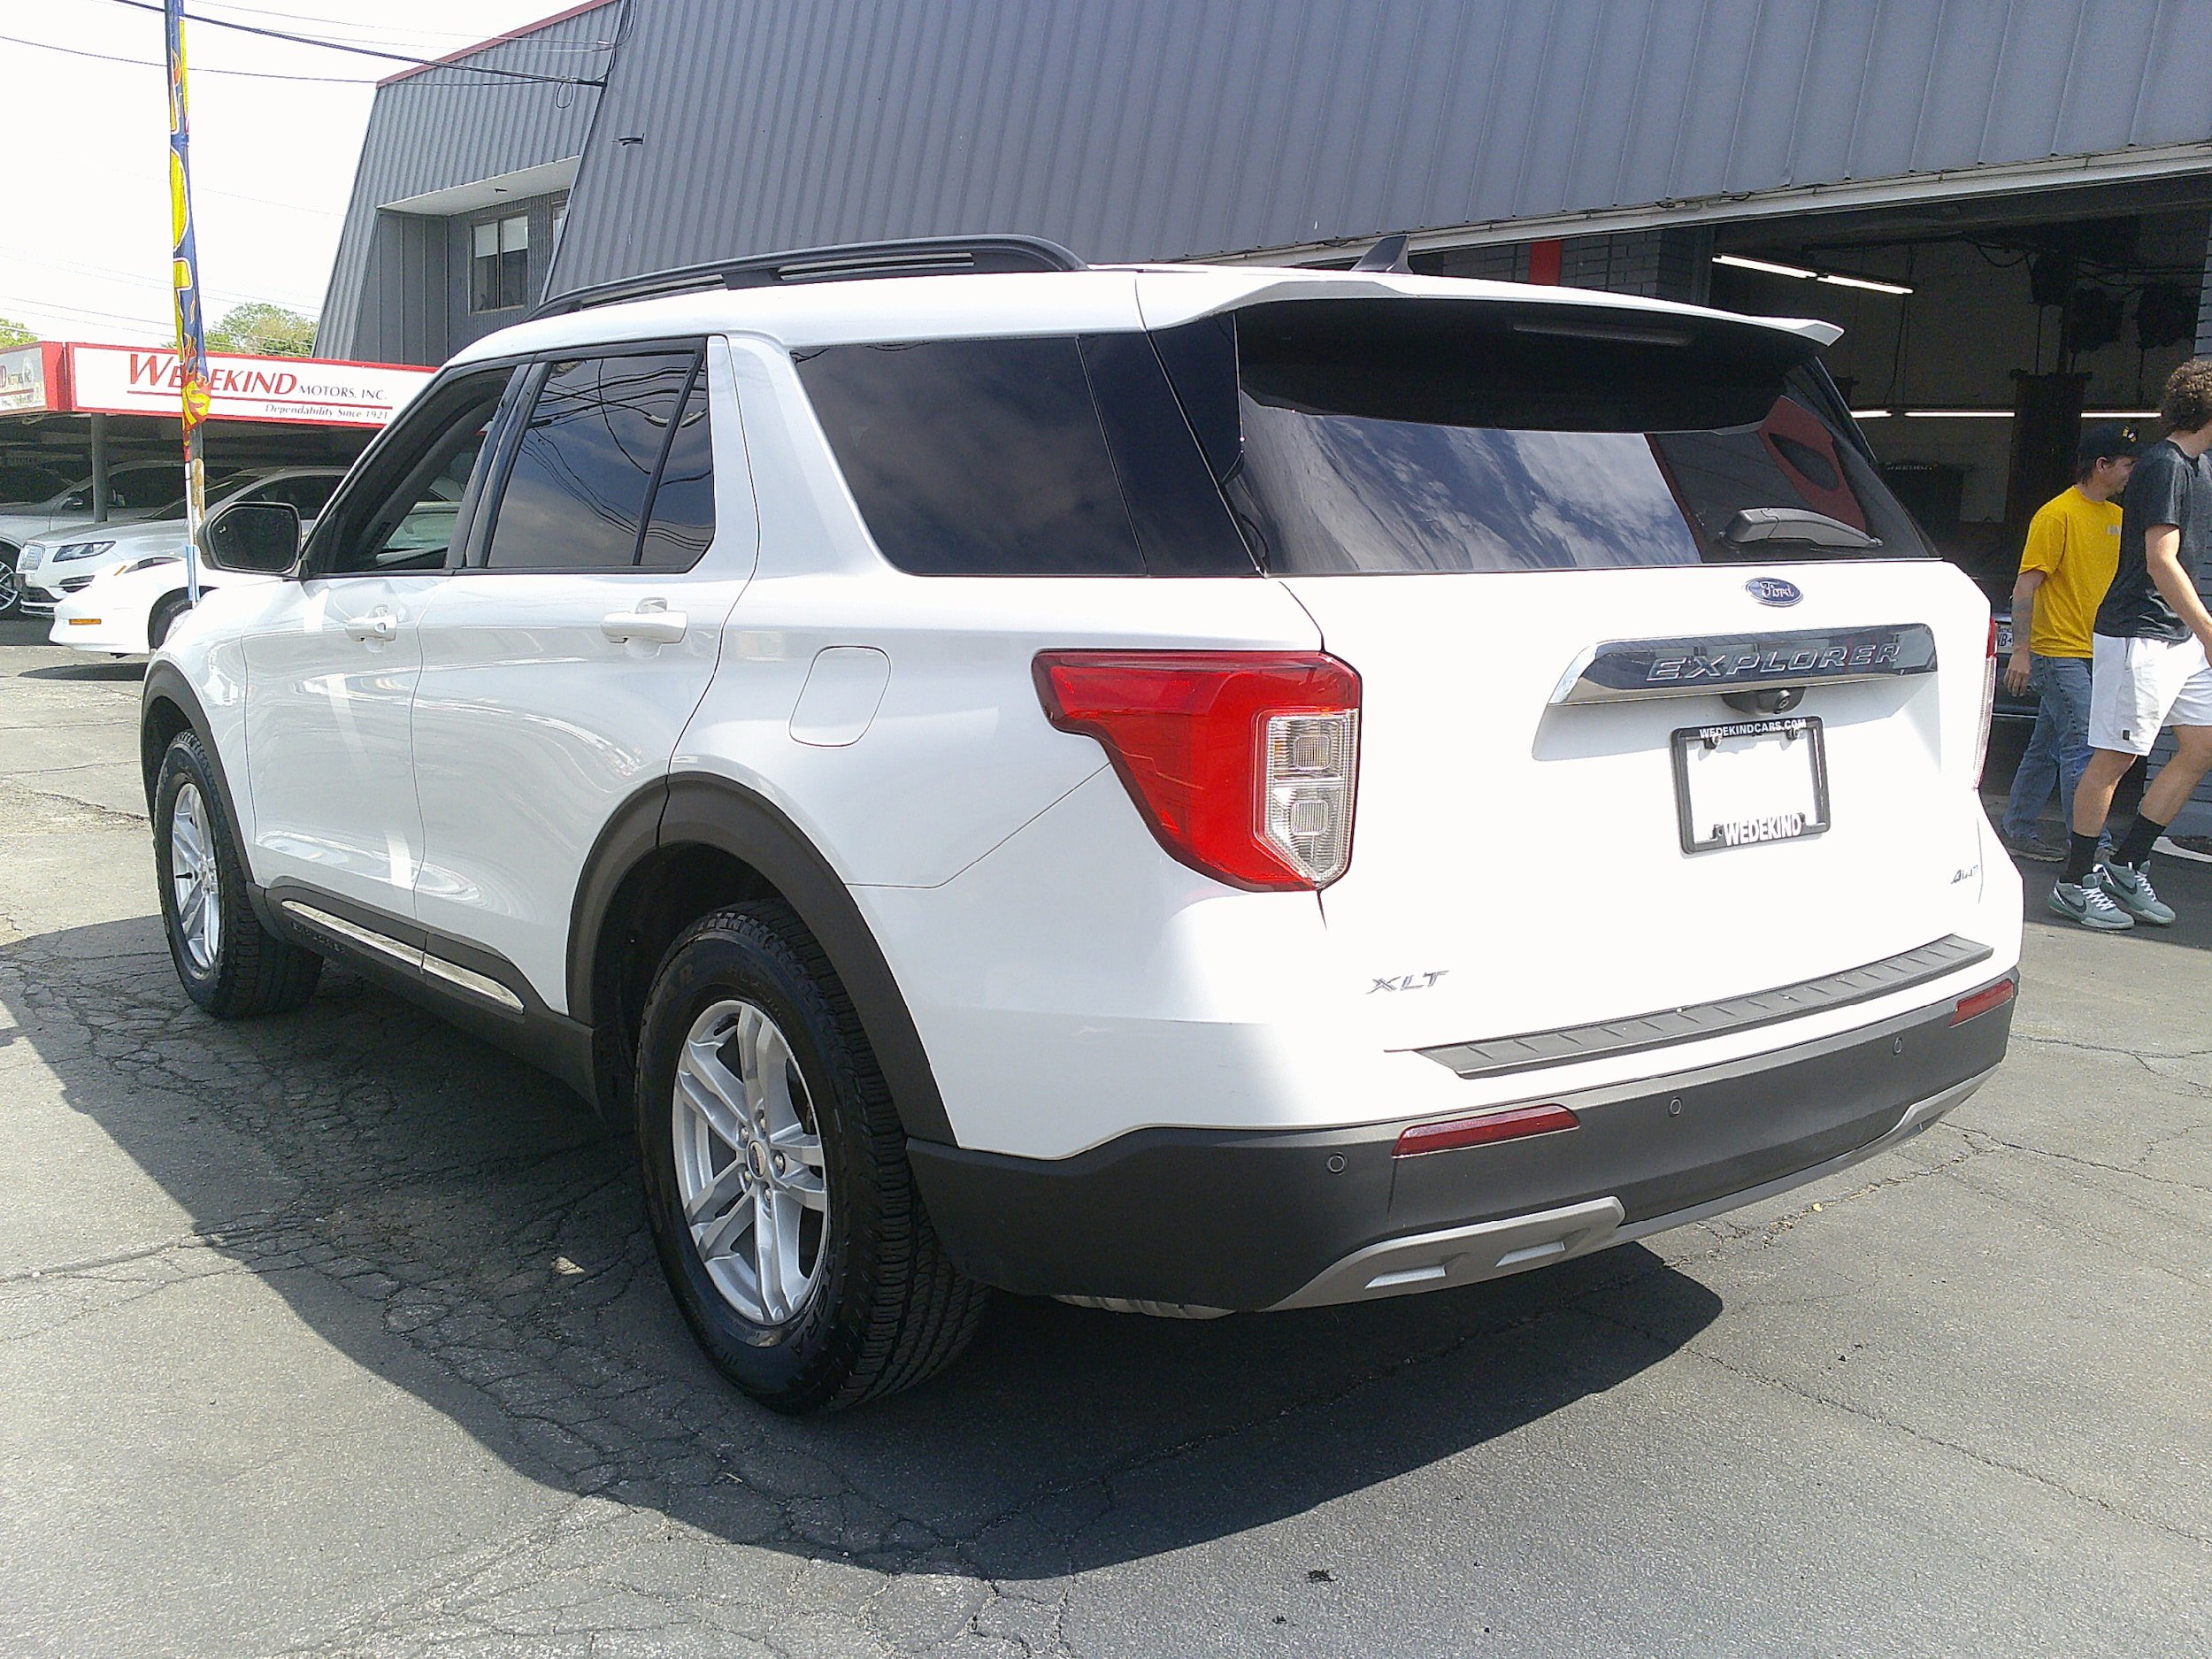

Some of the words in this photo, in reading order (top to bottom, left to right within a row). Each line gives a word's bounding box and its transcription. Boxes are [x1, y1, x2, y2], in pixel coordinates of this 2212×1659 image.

[129, 353, 297, 395] WEEKIND
[361, 388, 388, 400] INC.
[265, 403, 333, 419] Dependability
[338, 408, 362, 418] Since
[366, 411, 388, 419] 1921
[1646, 642, 1901, 681] EXPLORER
[1699, 718, 1807, 739] WEDEKINDCARS.COM
[1725, 813, 1802, 847] WEDEKIND
[1365, 970, 1450, 995] XLT
